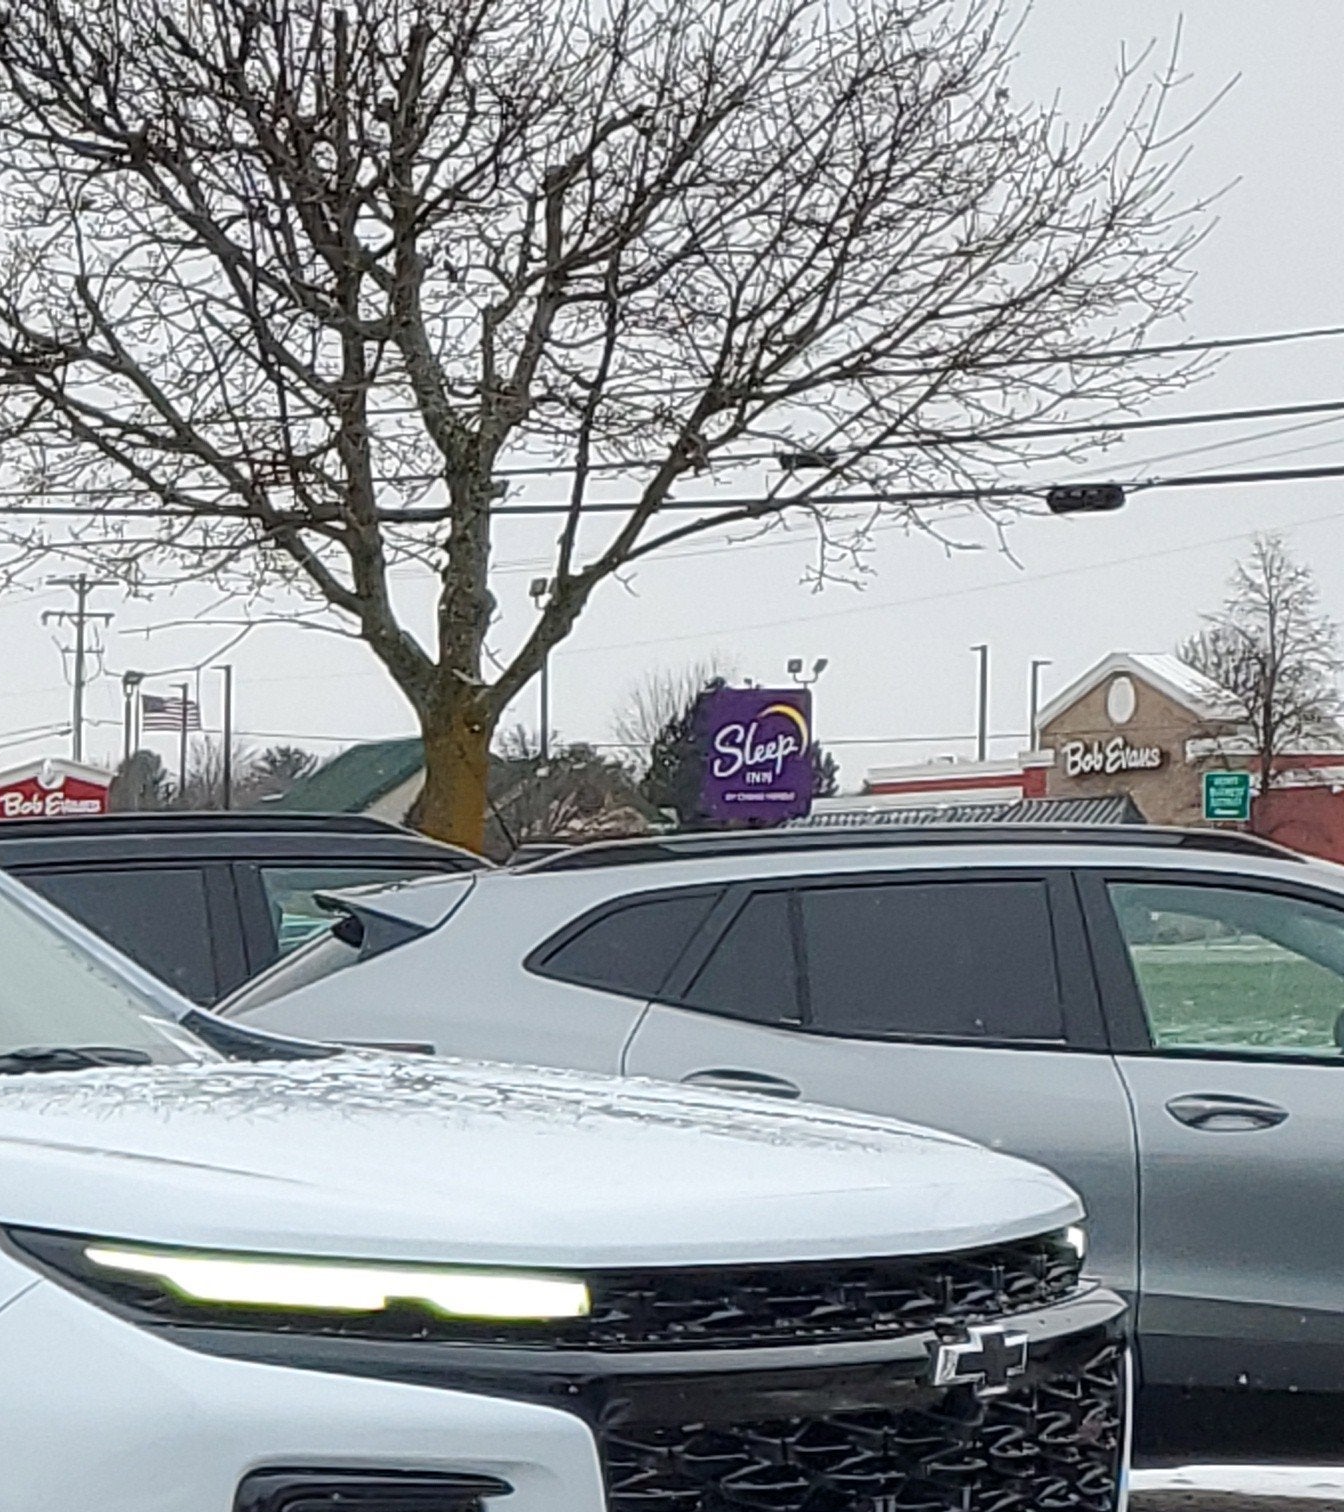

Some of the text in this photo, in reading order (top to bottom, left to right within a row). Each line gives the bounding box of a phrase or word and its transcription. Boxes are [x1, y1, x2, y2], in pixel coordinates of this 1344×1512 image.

[714, 722, 799, 777] Sleep
[1061, 736, 1162, 777] Bob Evans
[745, 771, 773, 784] INN
